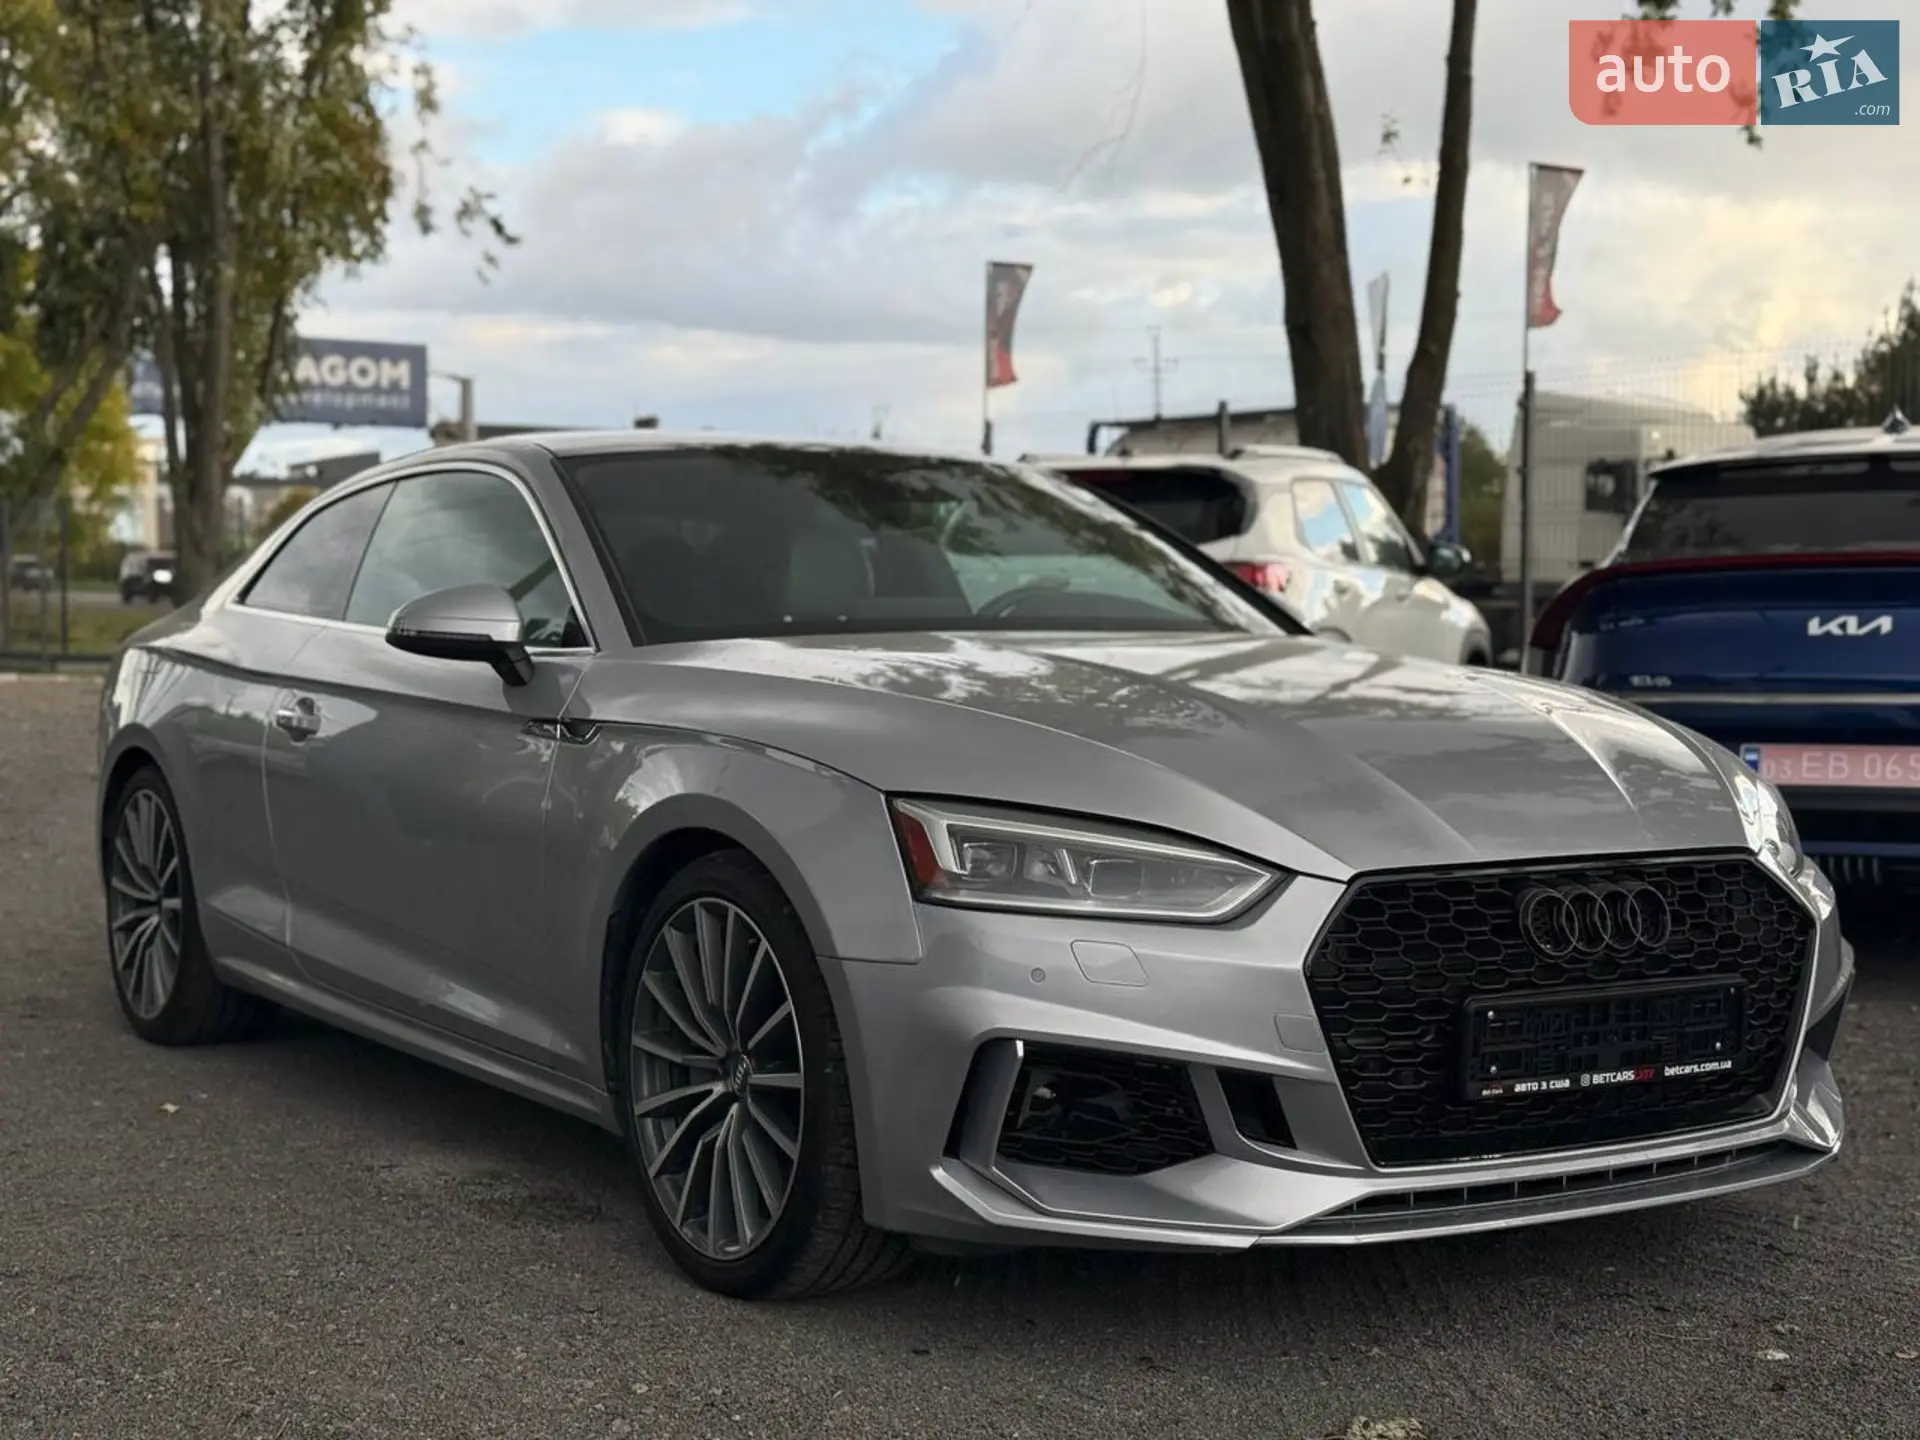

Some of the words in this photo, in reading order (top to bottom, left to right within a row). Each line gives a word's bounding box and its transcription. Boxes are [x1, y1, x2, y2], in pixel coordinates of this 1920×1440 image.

[279, 353, 412, 390] AGOM
[1807, 615, 1893, 636] KIA
[1801, 752, 1850, 780] EB
